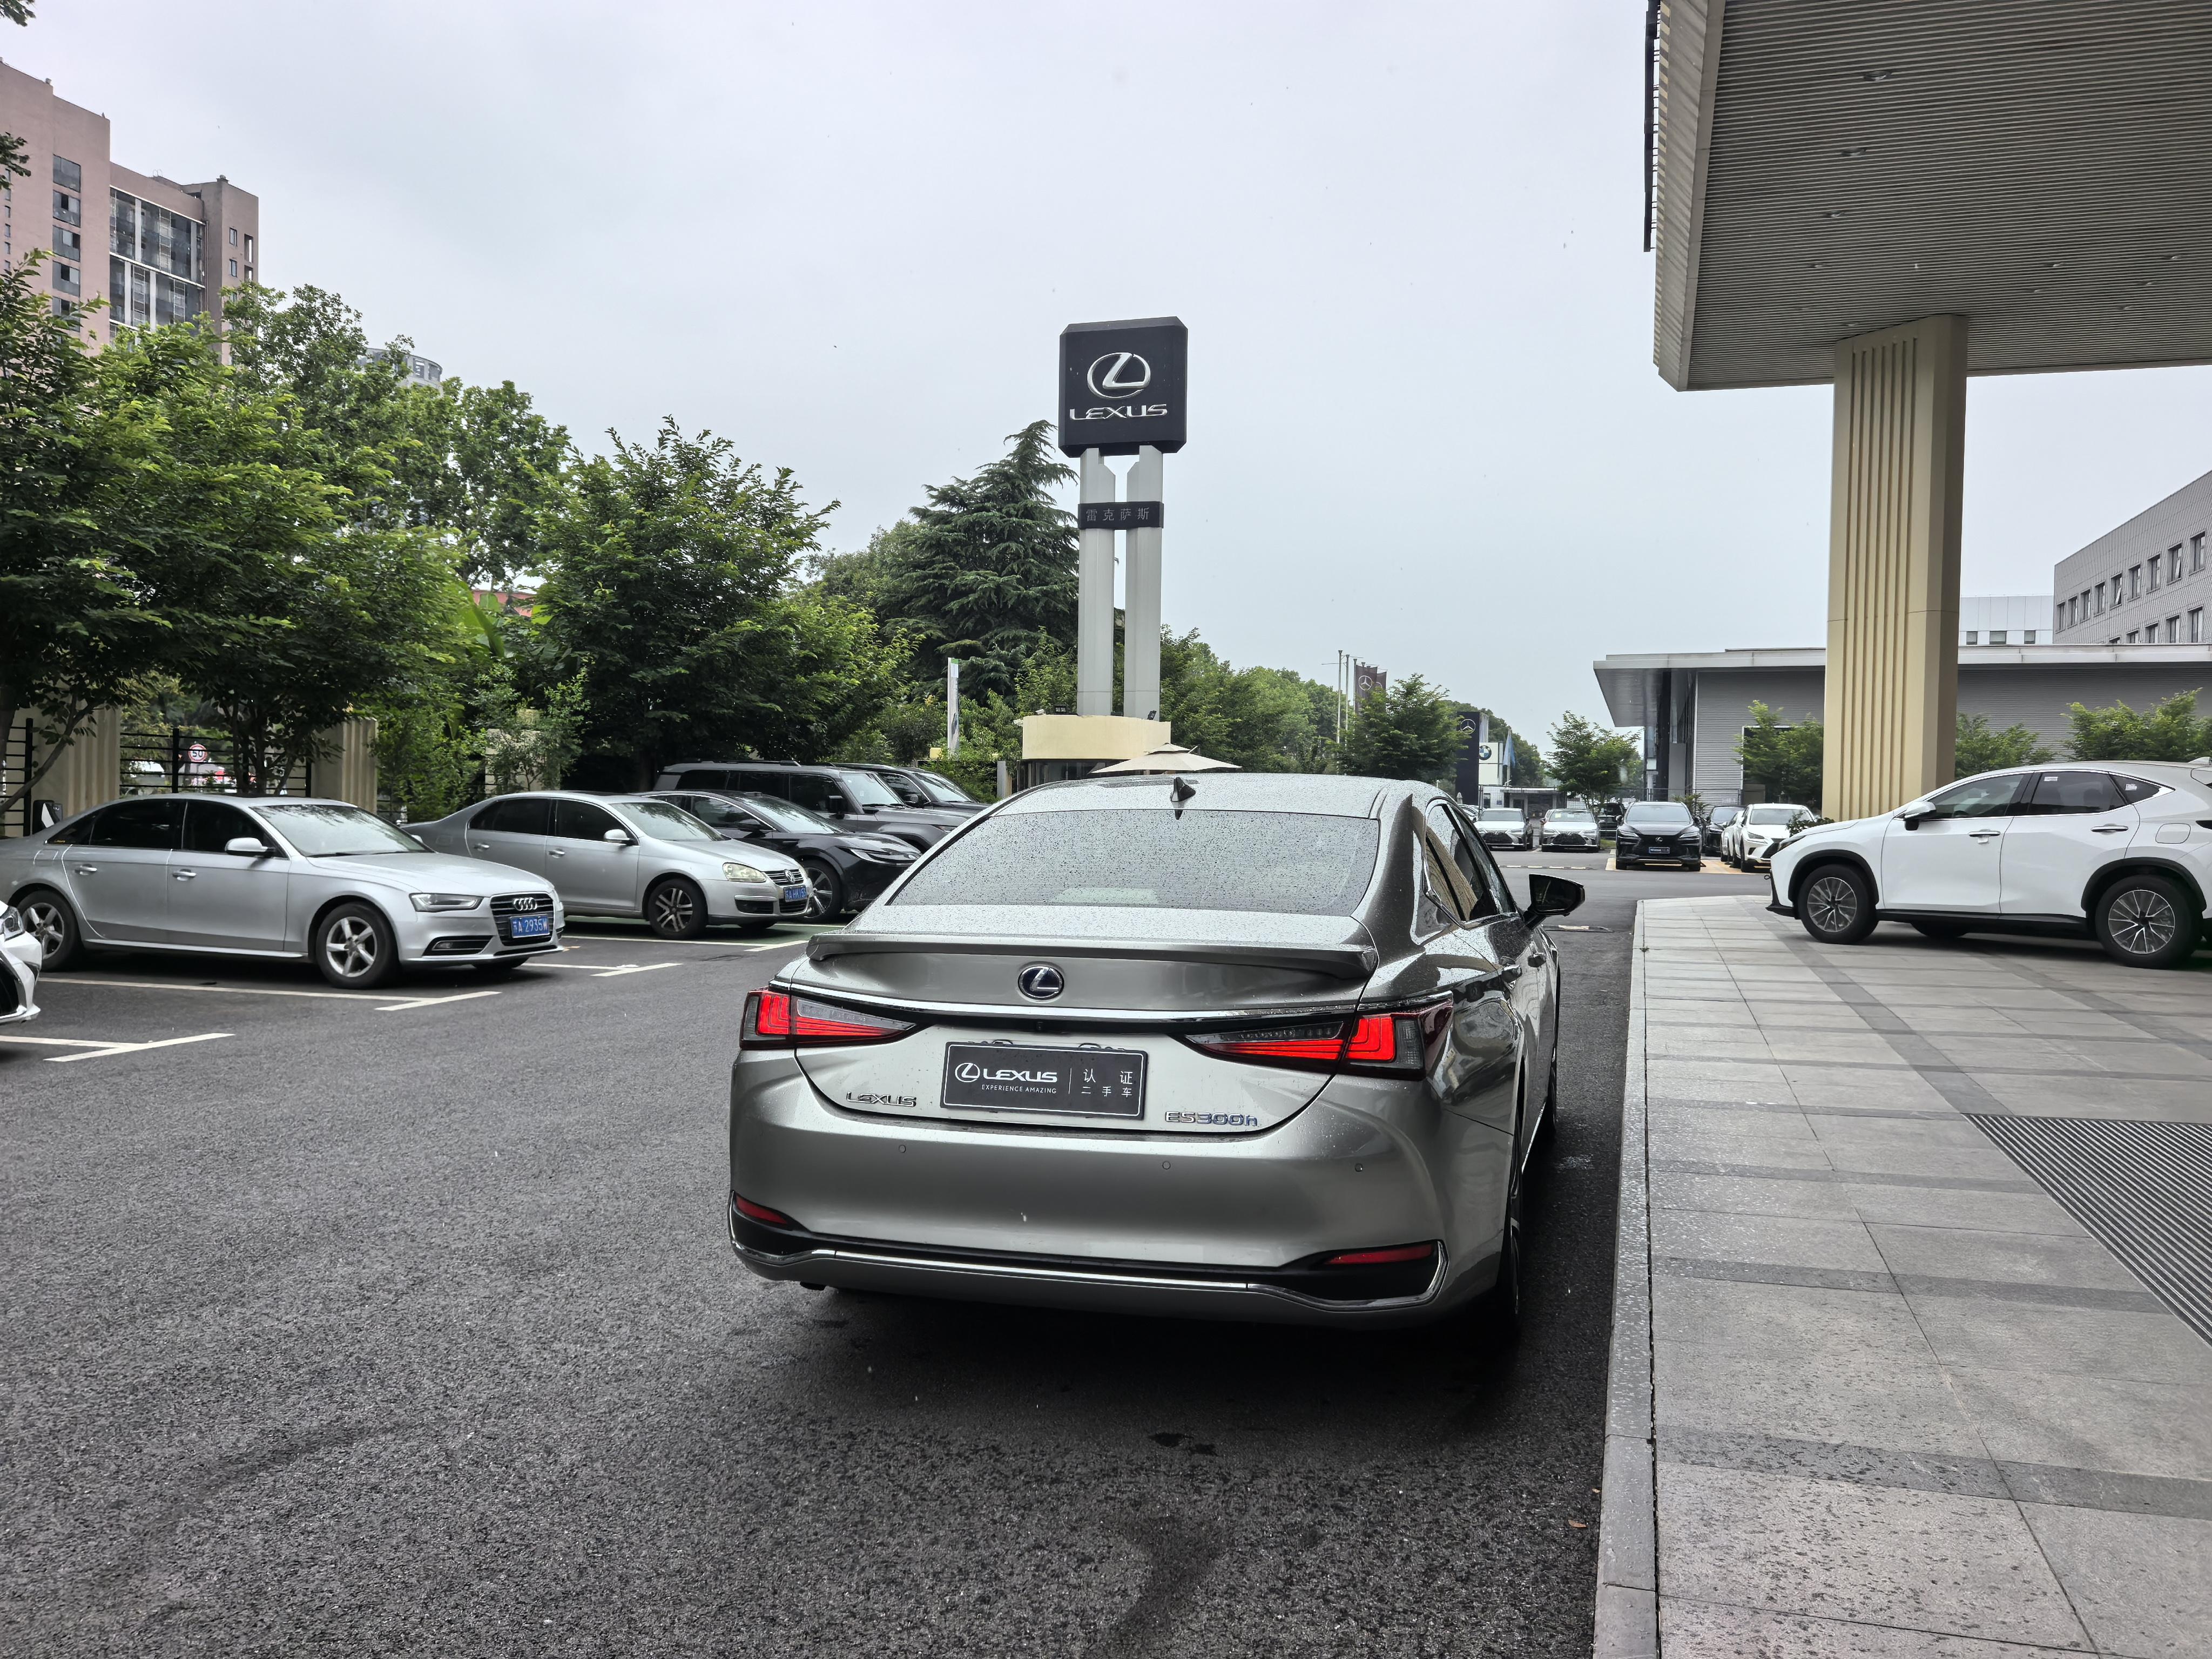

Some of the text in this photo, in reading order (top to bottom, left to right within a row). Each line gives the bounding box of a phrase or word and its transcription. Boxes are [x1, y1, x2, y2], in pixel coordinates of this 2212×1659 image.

[1069, 403, 1168, 420] LEXUS
[1086, 507, 1149, 521] 雷克萨斯
[983, 1068, 1058, 1083] LEXUS
[1083, 1068, 1133, 1084] 认证
[982, 1084, 1023, 1092] EXPERIENCE
[1081, 1086, 1132, 1098] 二手车
[846, 1091, 917, 1108] LEXUS
[1165, 1111, 1258, 1127] ES300h
